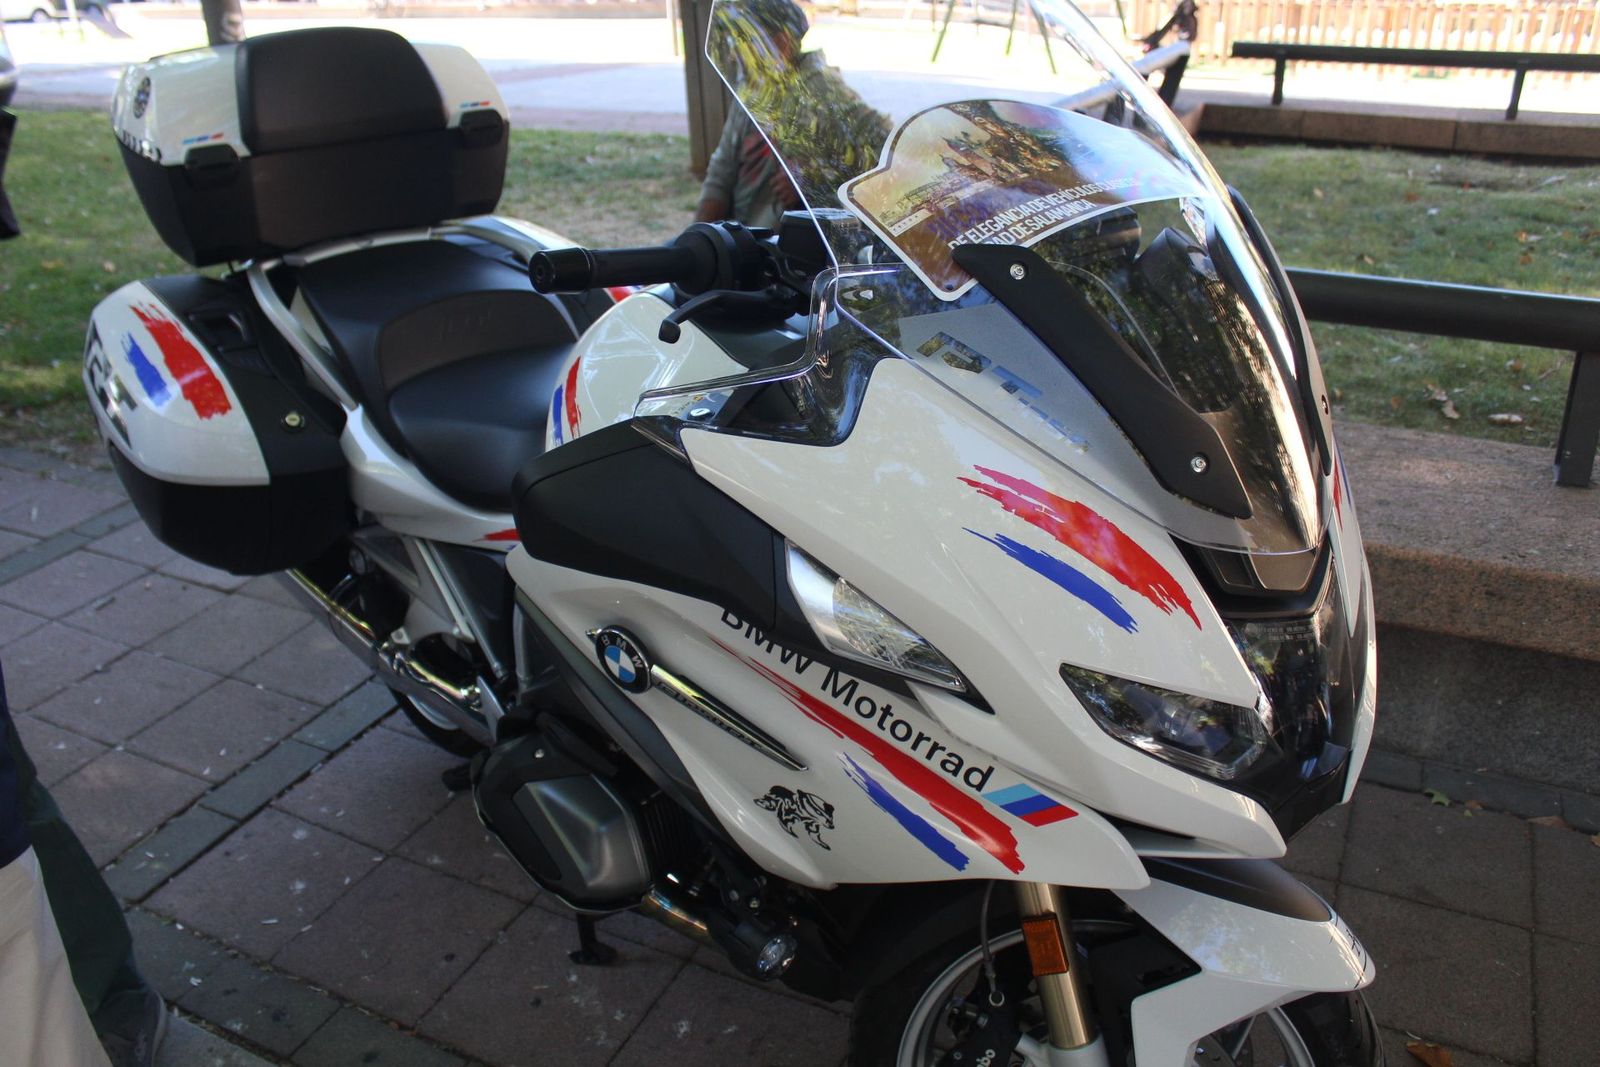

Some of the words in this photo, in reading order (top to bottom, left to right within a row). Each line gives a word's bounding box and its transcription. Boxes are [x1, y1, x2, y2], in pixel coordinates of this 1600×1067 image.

[965, 203, 1037, 245] ELEGANCIA
[1026, 194, 1053, 216] DE
[1044, 183, 1104, 208] VEHÍCULOS
[1007, 222, 1034, 240] DE
[1024, 198, 1097, 231] SALAMANCA
[602, 636, 643, 669] BMW
[820, 667, 996, 793] Motorrad
